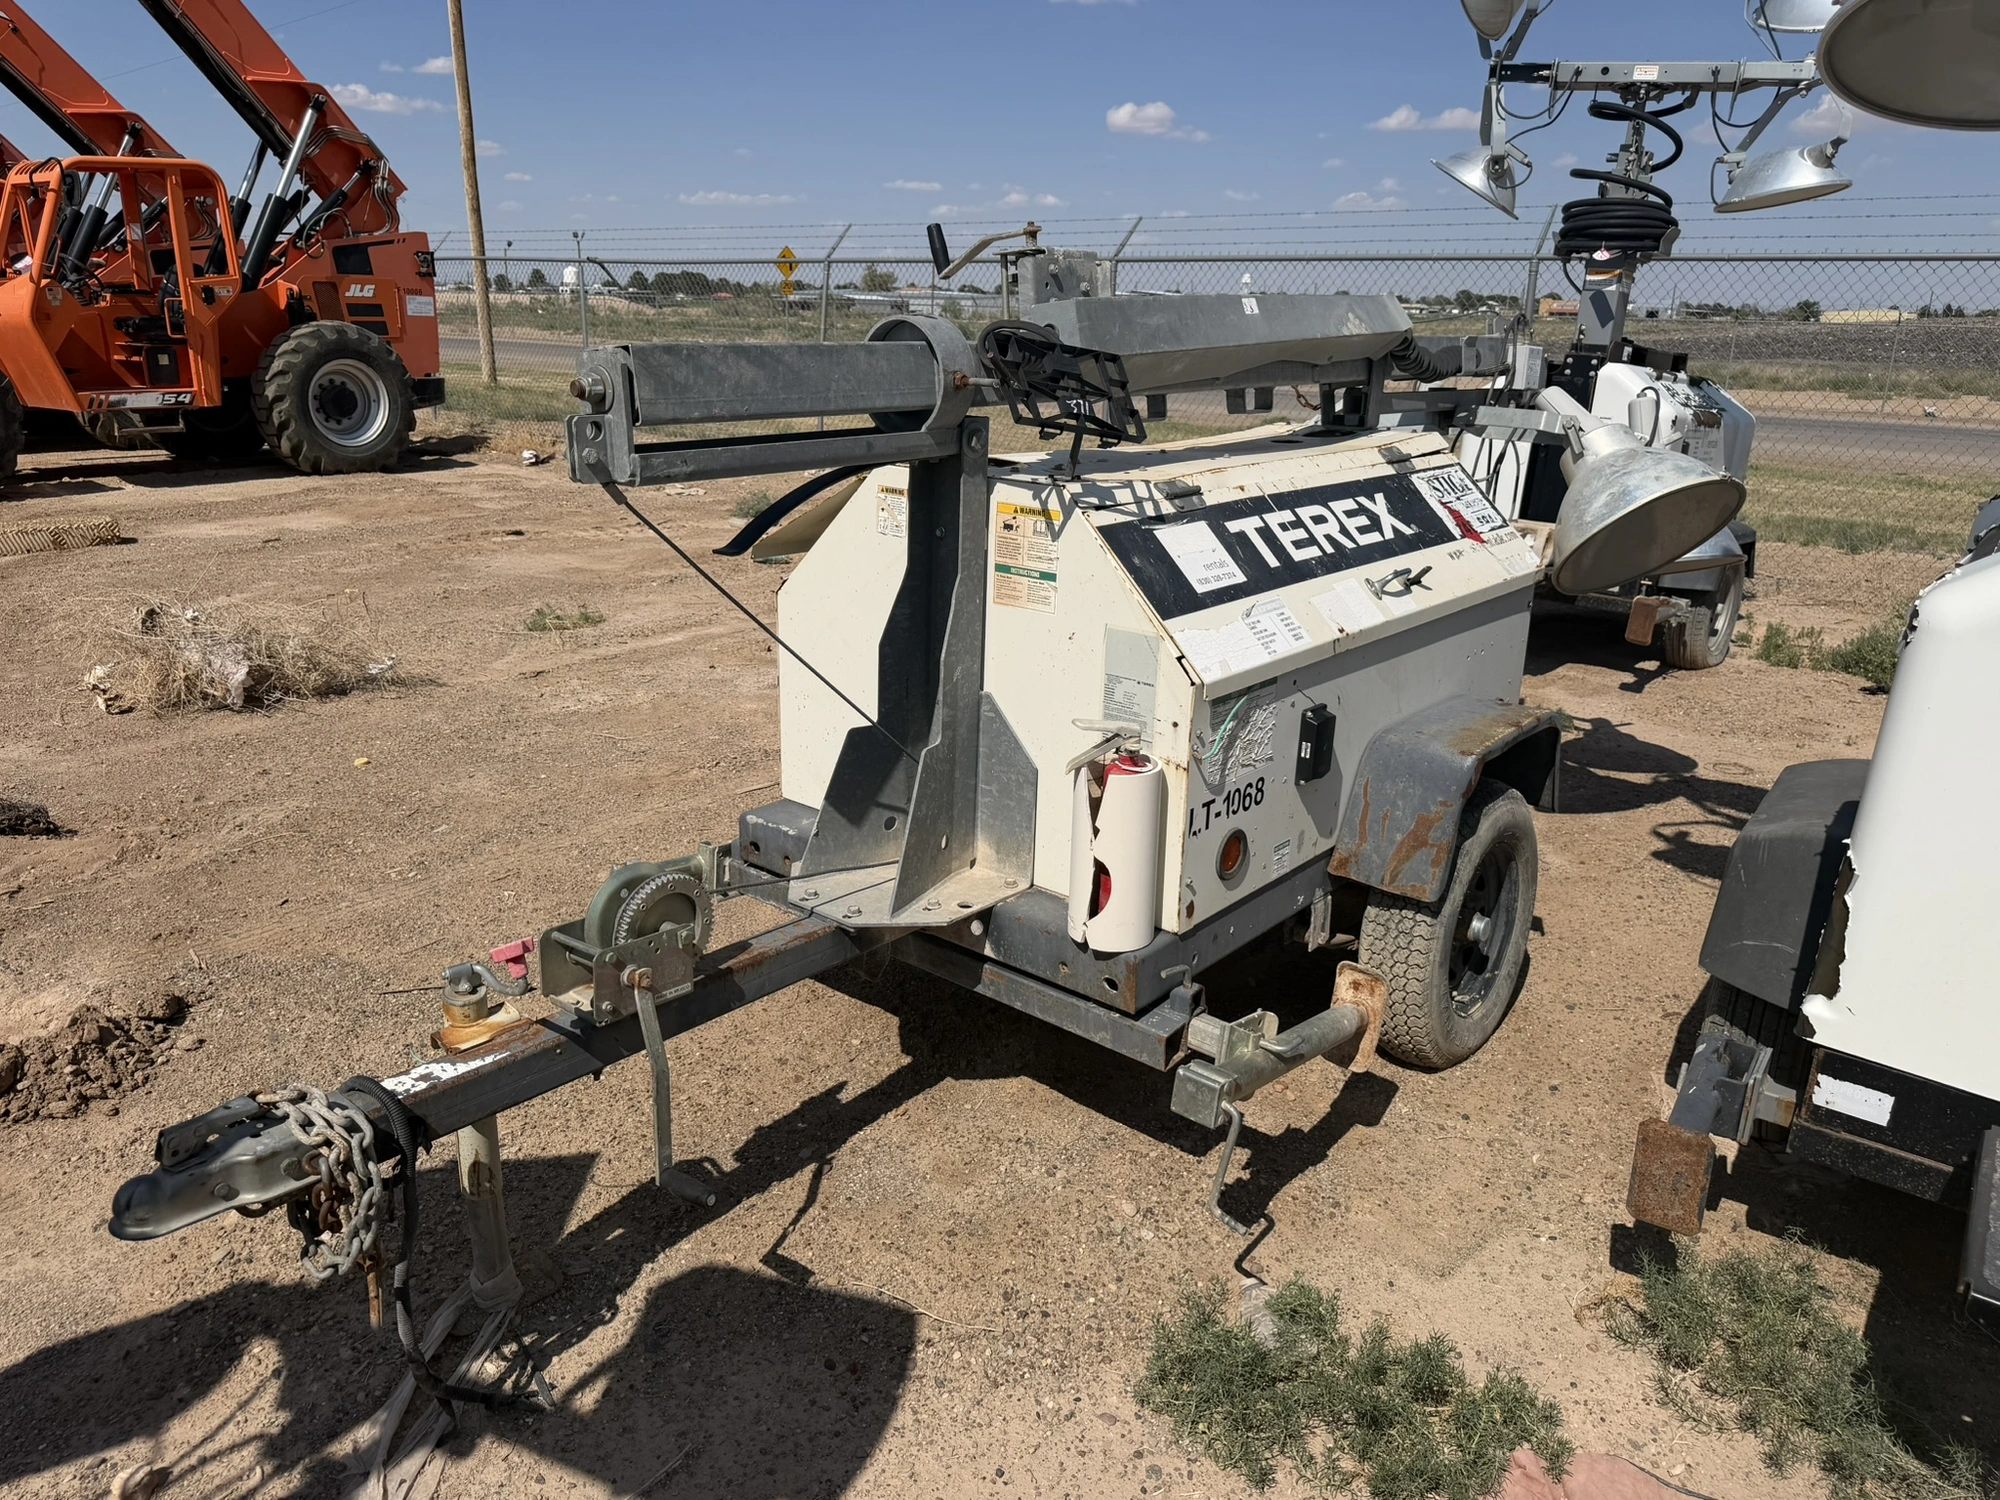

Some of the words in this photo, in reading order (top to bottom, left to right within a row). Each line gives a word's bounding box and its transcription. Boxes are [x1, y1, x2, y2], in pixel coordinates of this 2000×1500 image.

[344, 284, 375, 298] JLG
[1019, 506, 1046, 517] WARNING
[1224, 492, 1415, 568] TEREX
[1202, 558, 1230, 572] rentals
[1010, 567, 1040, 578] INSTRUCTIONS
[1188, 776, 1265, 839] LT-1068
